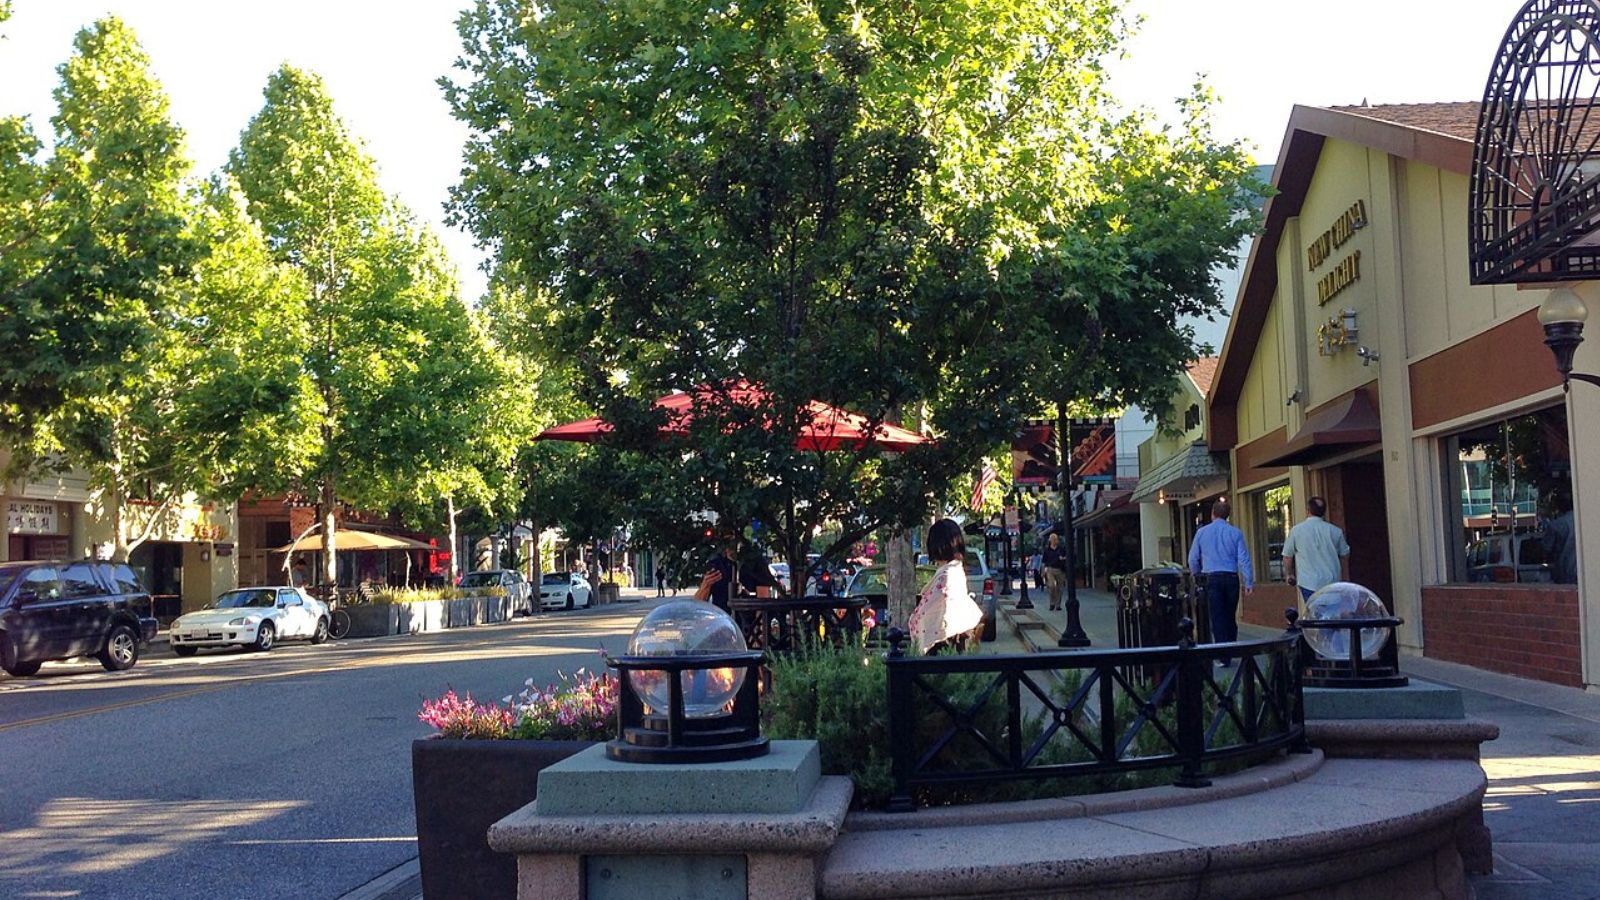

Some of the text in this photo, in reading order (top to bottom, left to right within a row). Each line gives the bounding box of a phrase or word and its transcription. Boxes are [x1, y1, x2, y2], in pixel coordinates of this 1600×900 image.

[1308, 199, 1368, 272] NEW CHINA
[1318, 250, 1361, 306] DELIGHT
[20, 504, 52, 514] HOLIDAYS
